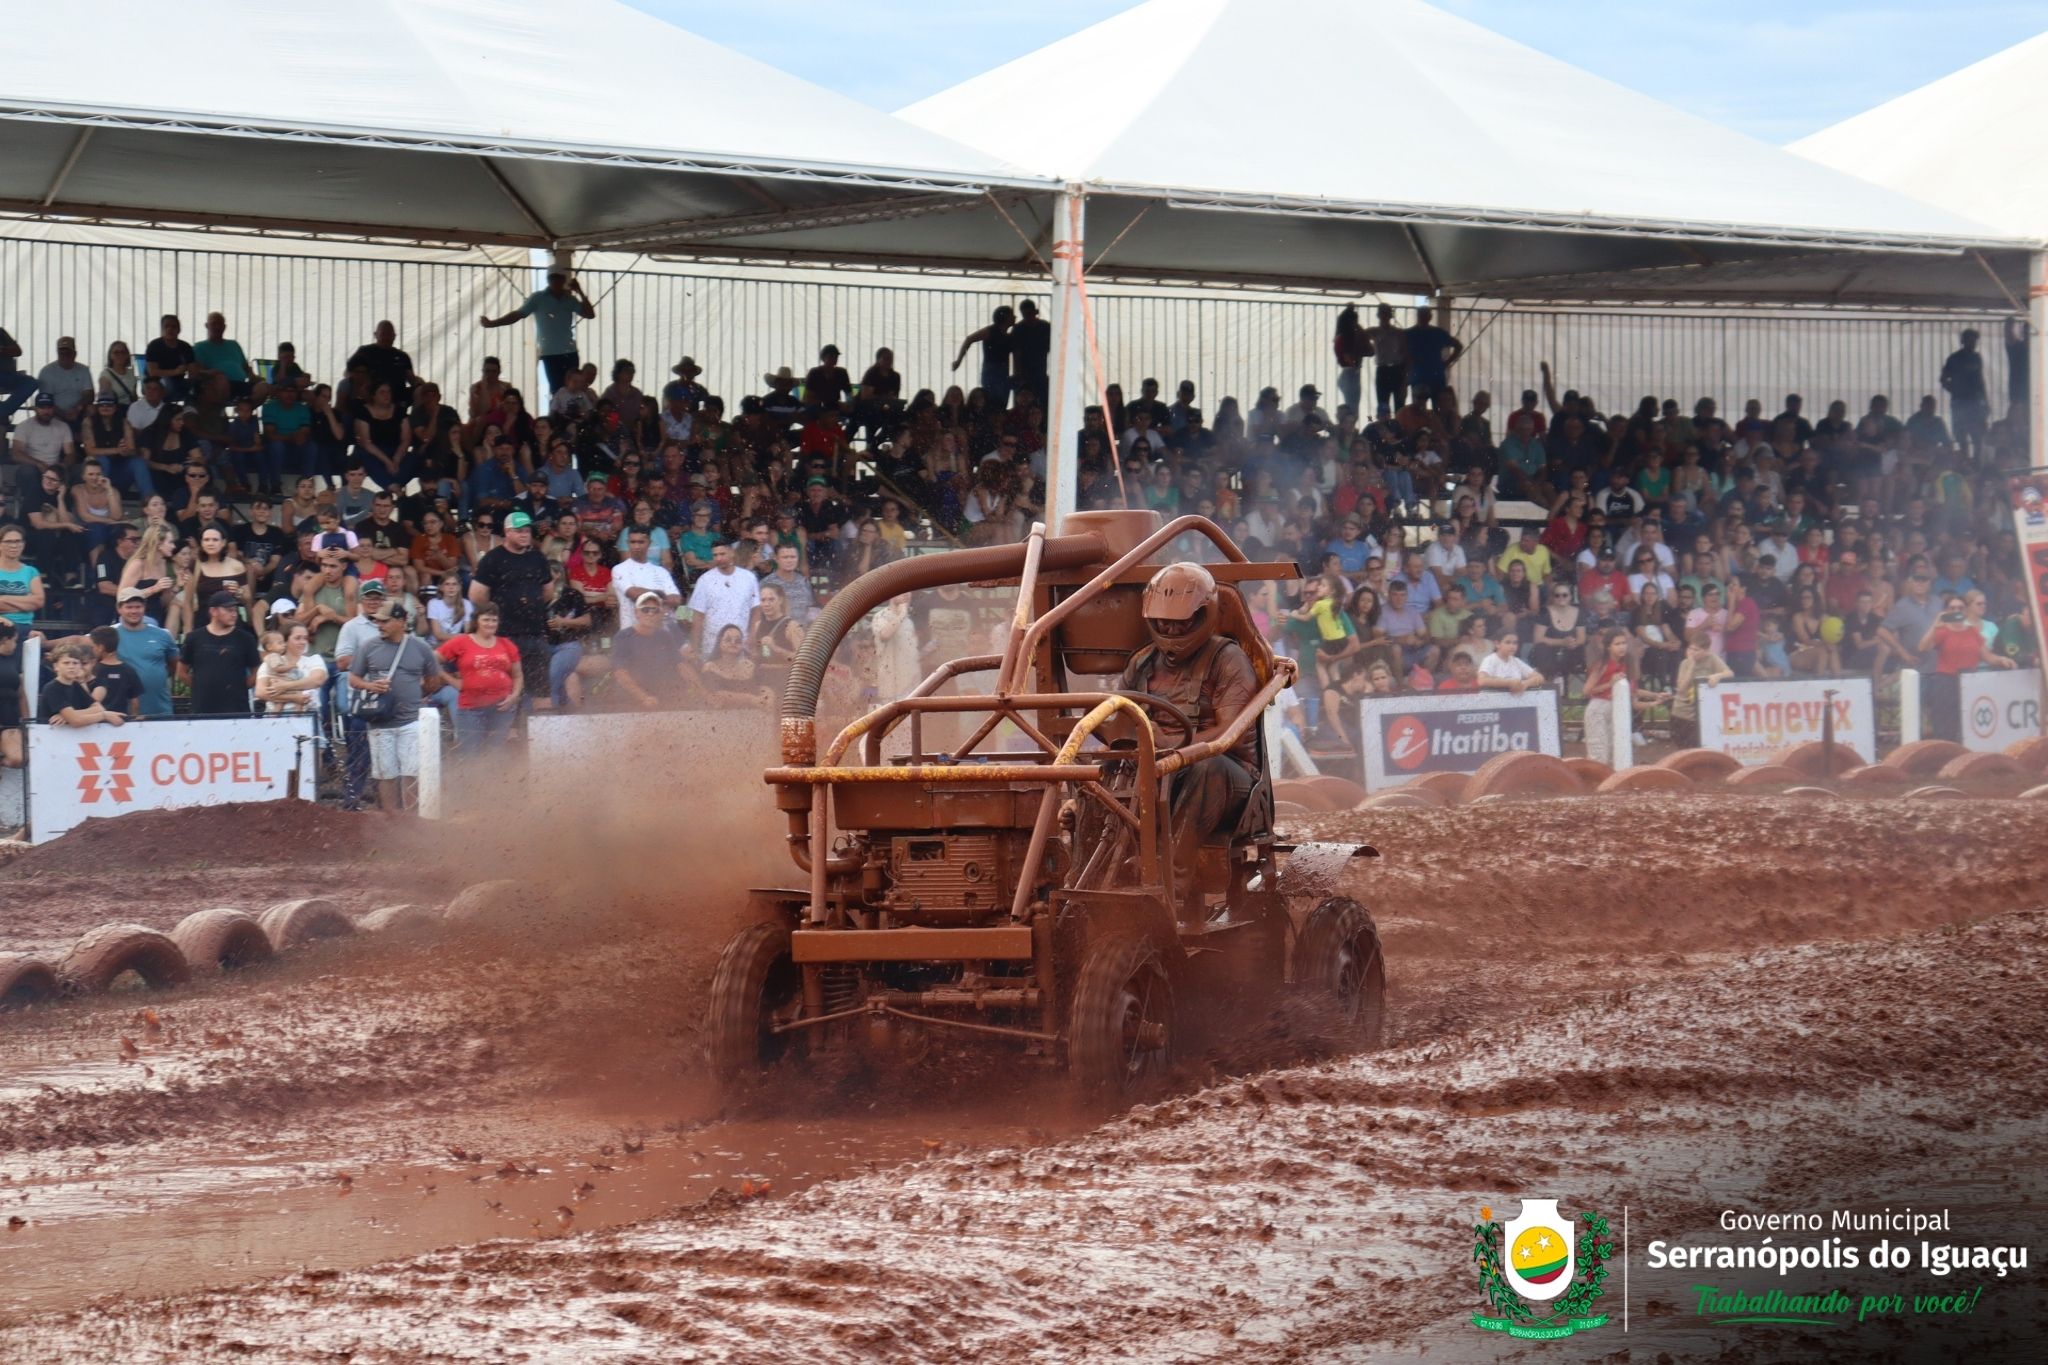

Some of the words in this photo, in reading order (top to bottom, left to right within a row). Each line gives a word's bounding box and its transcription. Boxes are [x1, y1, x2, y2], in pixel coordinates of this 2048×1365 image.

[1457, 712, 1500, 725] PEDREIRA
[1720, 693, 1853, 743] Engevx
[1431, 725, 1529, 755] Itatiba
[151, 751, 272, 786] COPEL
